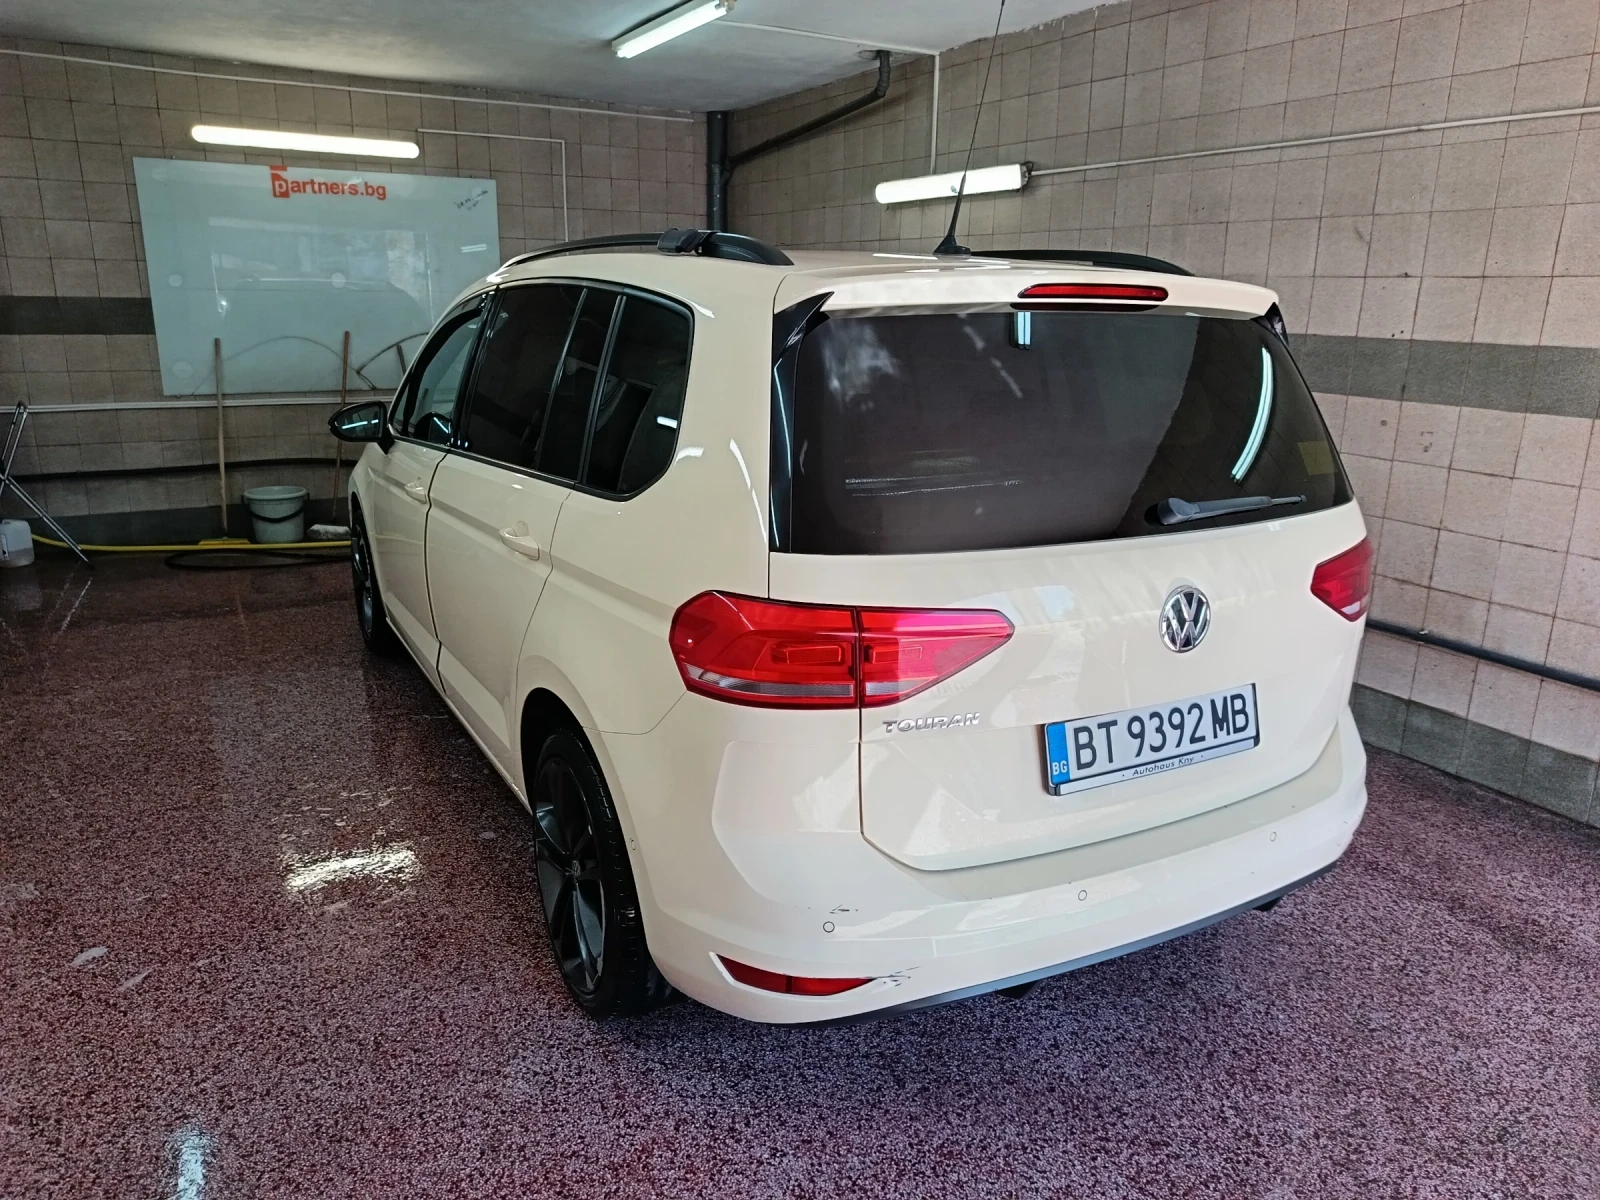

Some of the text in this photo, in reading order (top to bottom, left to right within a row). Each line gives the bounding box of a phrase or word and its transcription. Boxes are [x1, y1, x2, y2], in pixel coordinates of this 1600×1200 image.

[271, 172, 387, 201] partners.bg
[882, 712, 980, 734] TOURAN
[1073, 692, 1250, 771] BT 9392 MB
[1052, 760, 1068, 776] BG
[1132, 756, 1194, 776] Autohaus Kny
